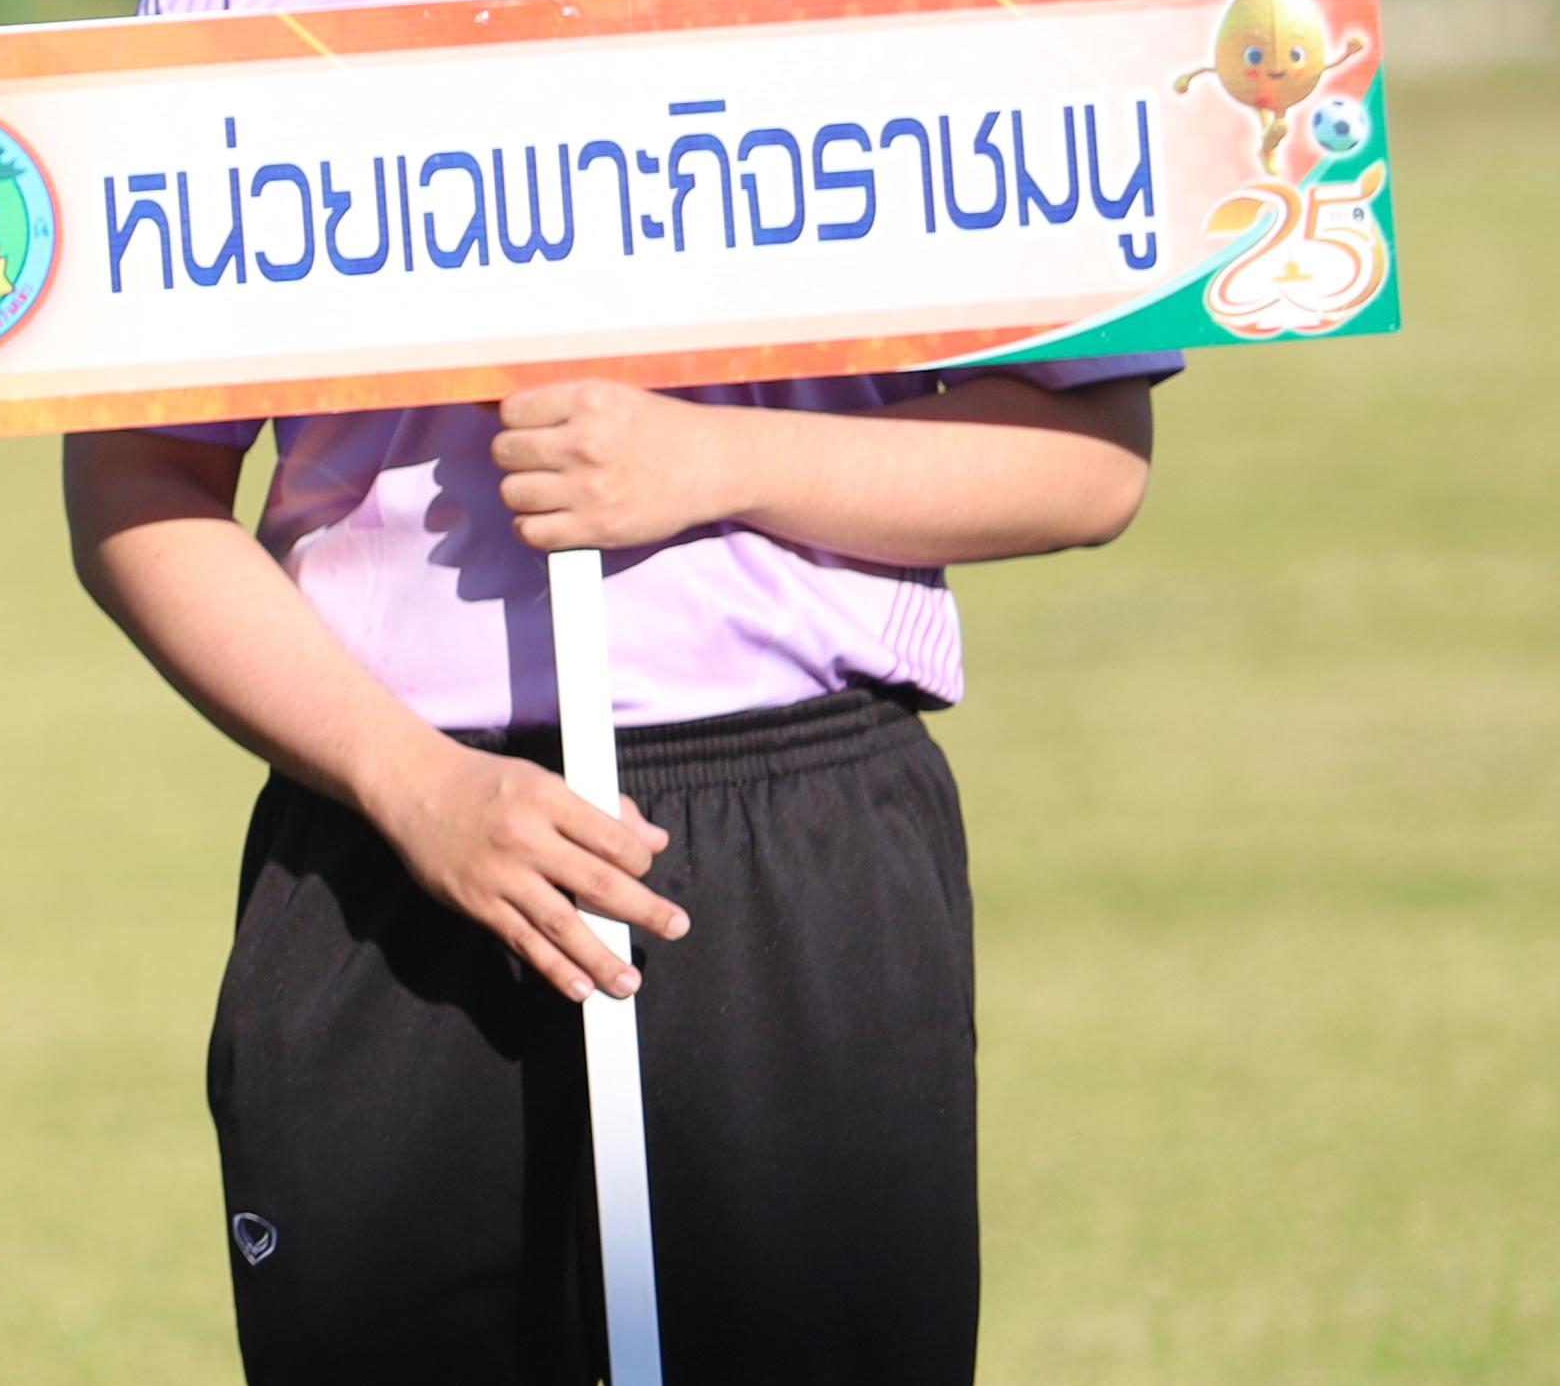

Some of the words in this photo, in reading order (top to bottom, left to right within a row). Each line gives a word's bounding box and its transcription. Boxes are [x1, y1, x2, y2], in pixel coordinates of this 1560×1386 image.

[103, 99, 1158, 293] หน่วยเฉพาะกิจราชมนู
